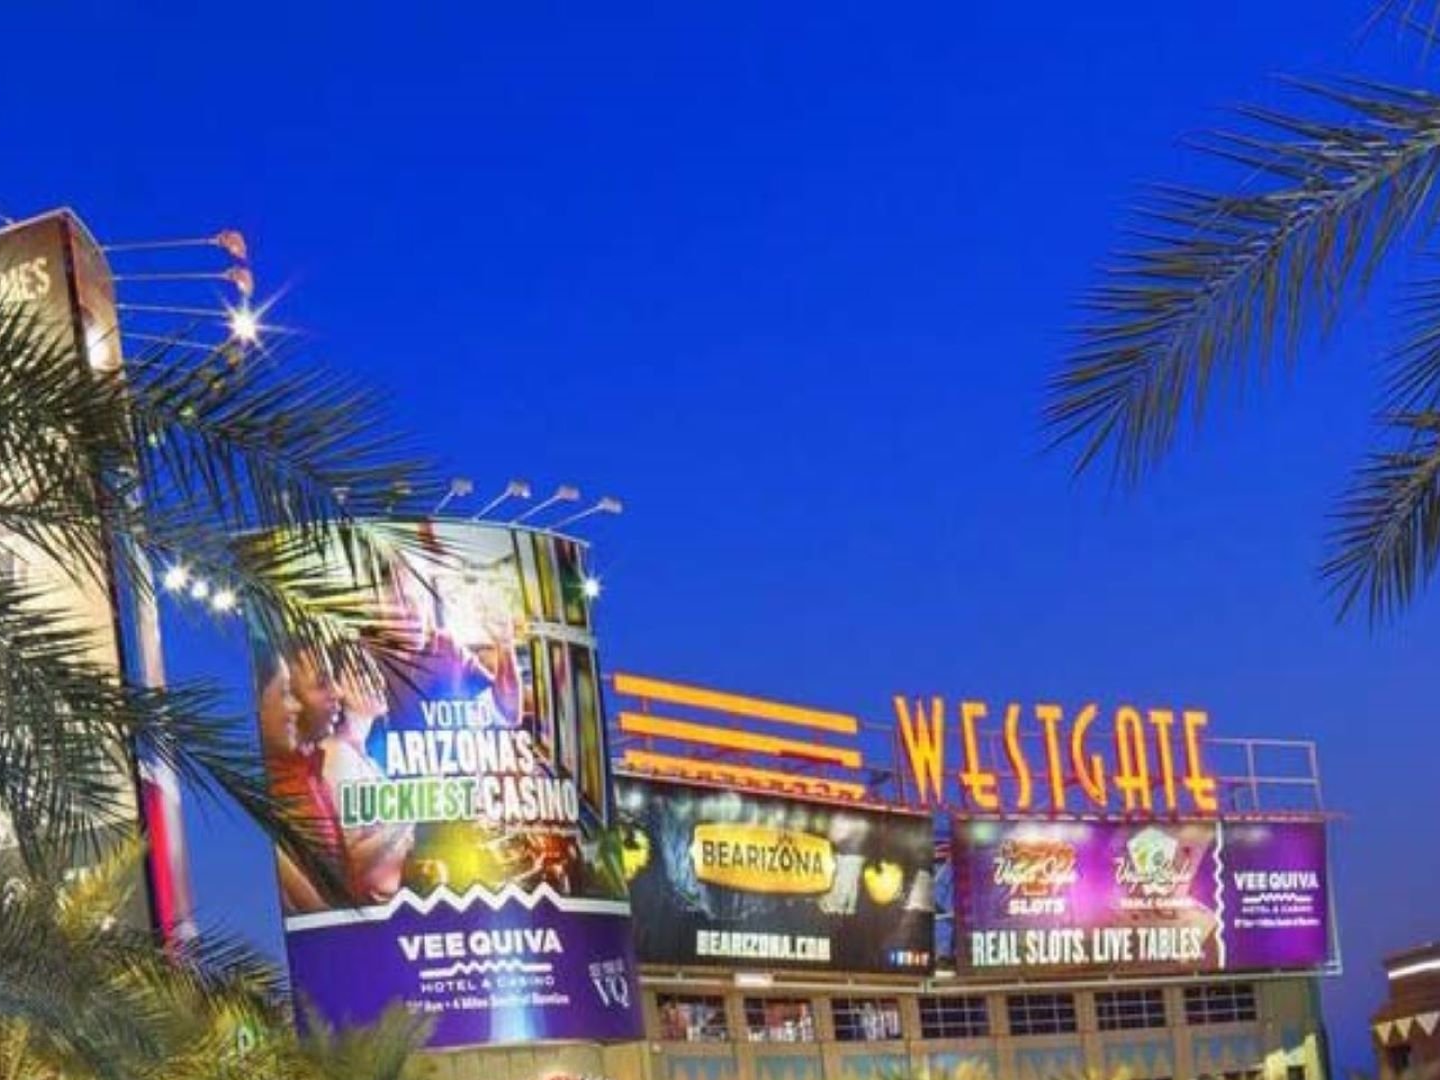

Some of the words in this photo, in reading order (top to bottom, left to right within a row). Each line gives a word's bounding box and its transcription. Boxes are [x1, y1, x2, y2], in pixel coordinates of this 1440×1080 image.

[422, 699, 495, 727] VOTED
[386, 729, 534, 776] ARIZONA'S
[893, 694, 1219, 810] WESTGATE
[341, 778, 477, 829] LUCKIEST
[483, 775, 580, 821] CASINO
[701, 839, 825, 876] BEARIZONA
[1234, 871, 1268, 891] VEE
[1269, 869, 1319, 890] QUIVA
[1007, 898, 1066, 916] SLOTS
[397, 932, 466, 961] VEE
[469, 927, 564, 957] QUIVA
[696, 930, 831, 961] BEARIZONA.COM
[972, 930, 1022, 967] REAL
[1026, 928, 1090, 965] SLOTS.
[1093, 926, 1133, 962] LIVE
[1137, 925, 1206, 962] TABLES.
[421, 979, 477, 994] HOTEL
[497, 975, 555, 989] CASINO
[592, 973, 630, 1009] VQ
